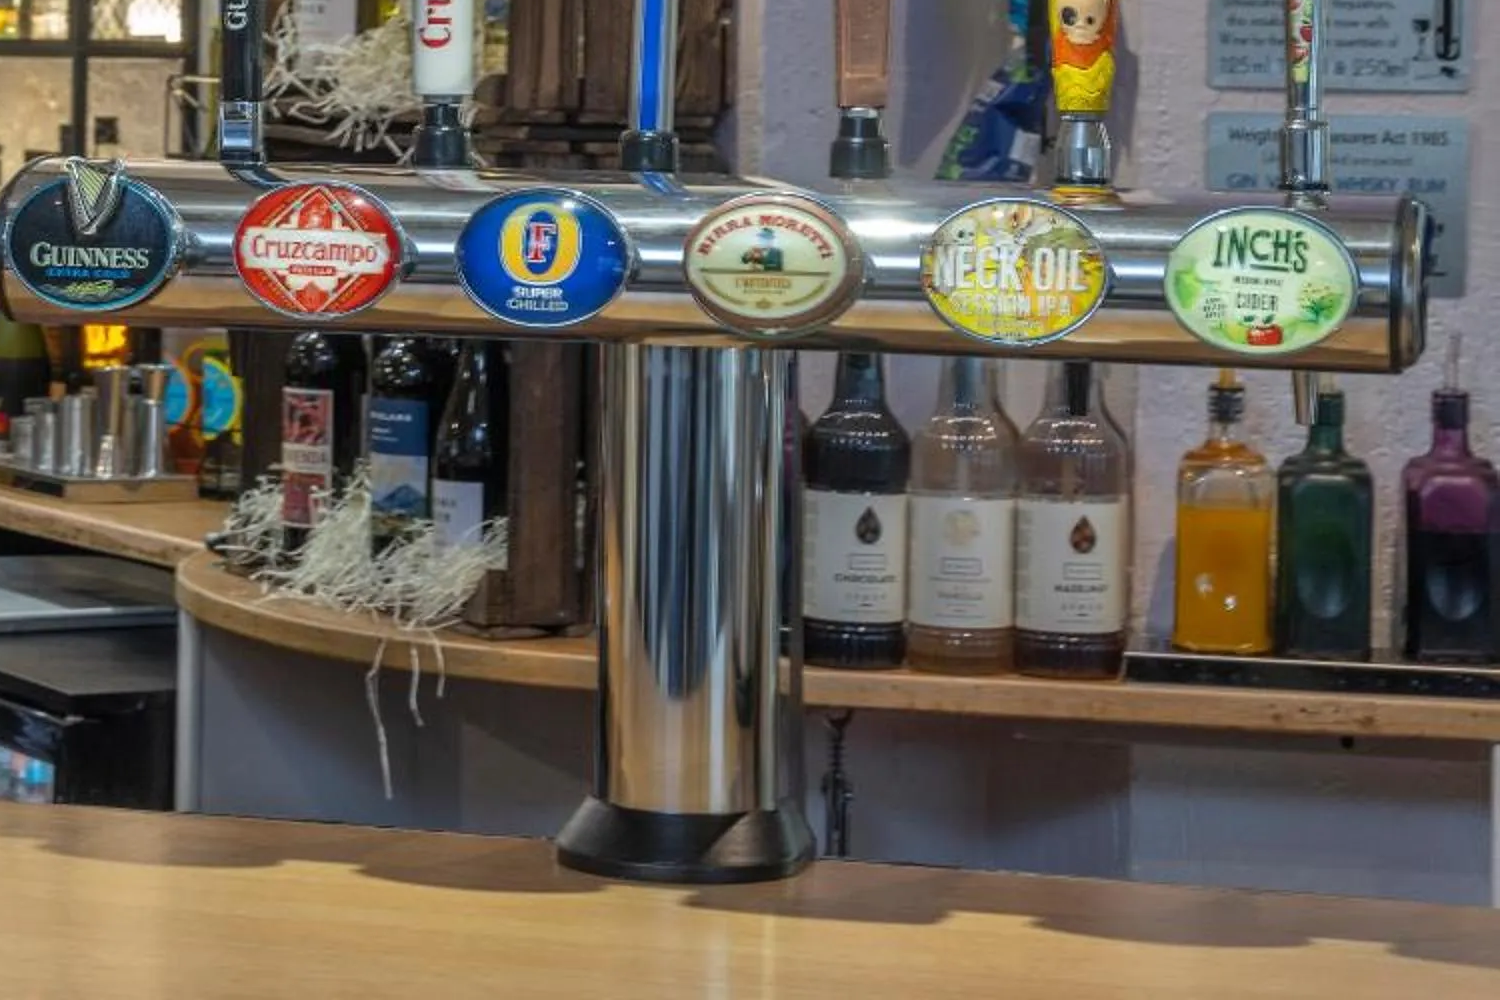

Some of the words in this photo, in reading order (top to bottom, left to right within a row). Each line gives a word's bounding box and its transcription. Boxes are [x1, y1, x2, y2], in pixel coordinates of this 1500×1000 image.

[29, 241, 150, 269] GUINNESS
[252, 234, 378, 265] Cruzcampo
[933, 244, 1023, 291] NECK
[1033, 247, 1089, 291] OIL
